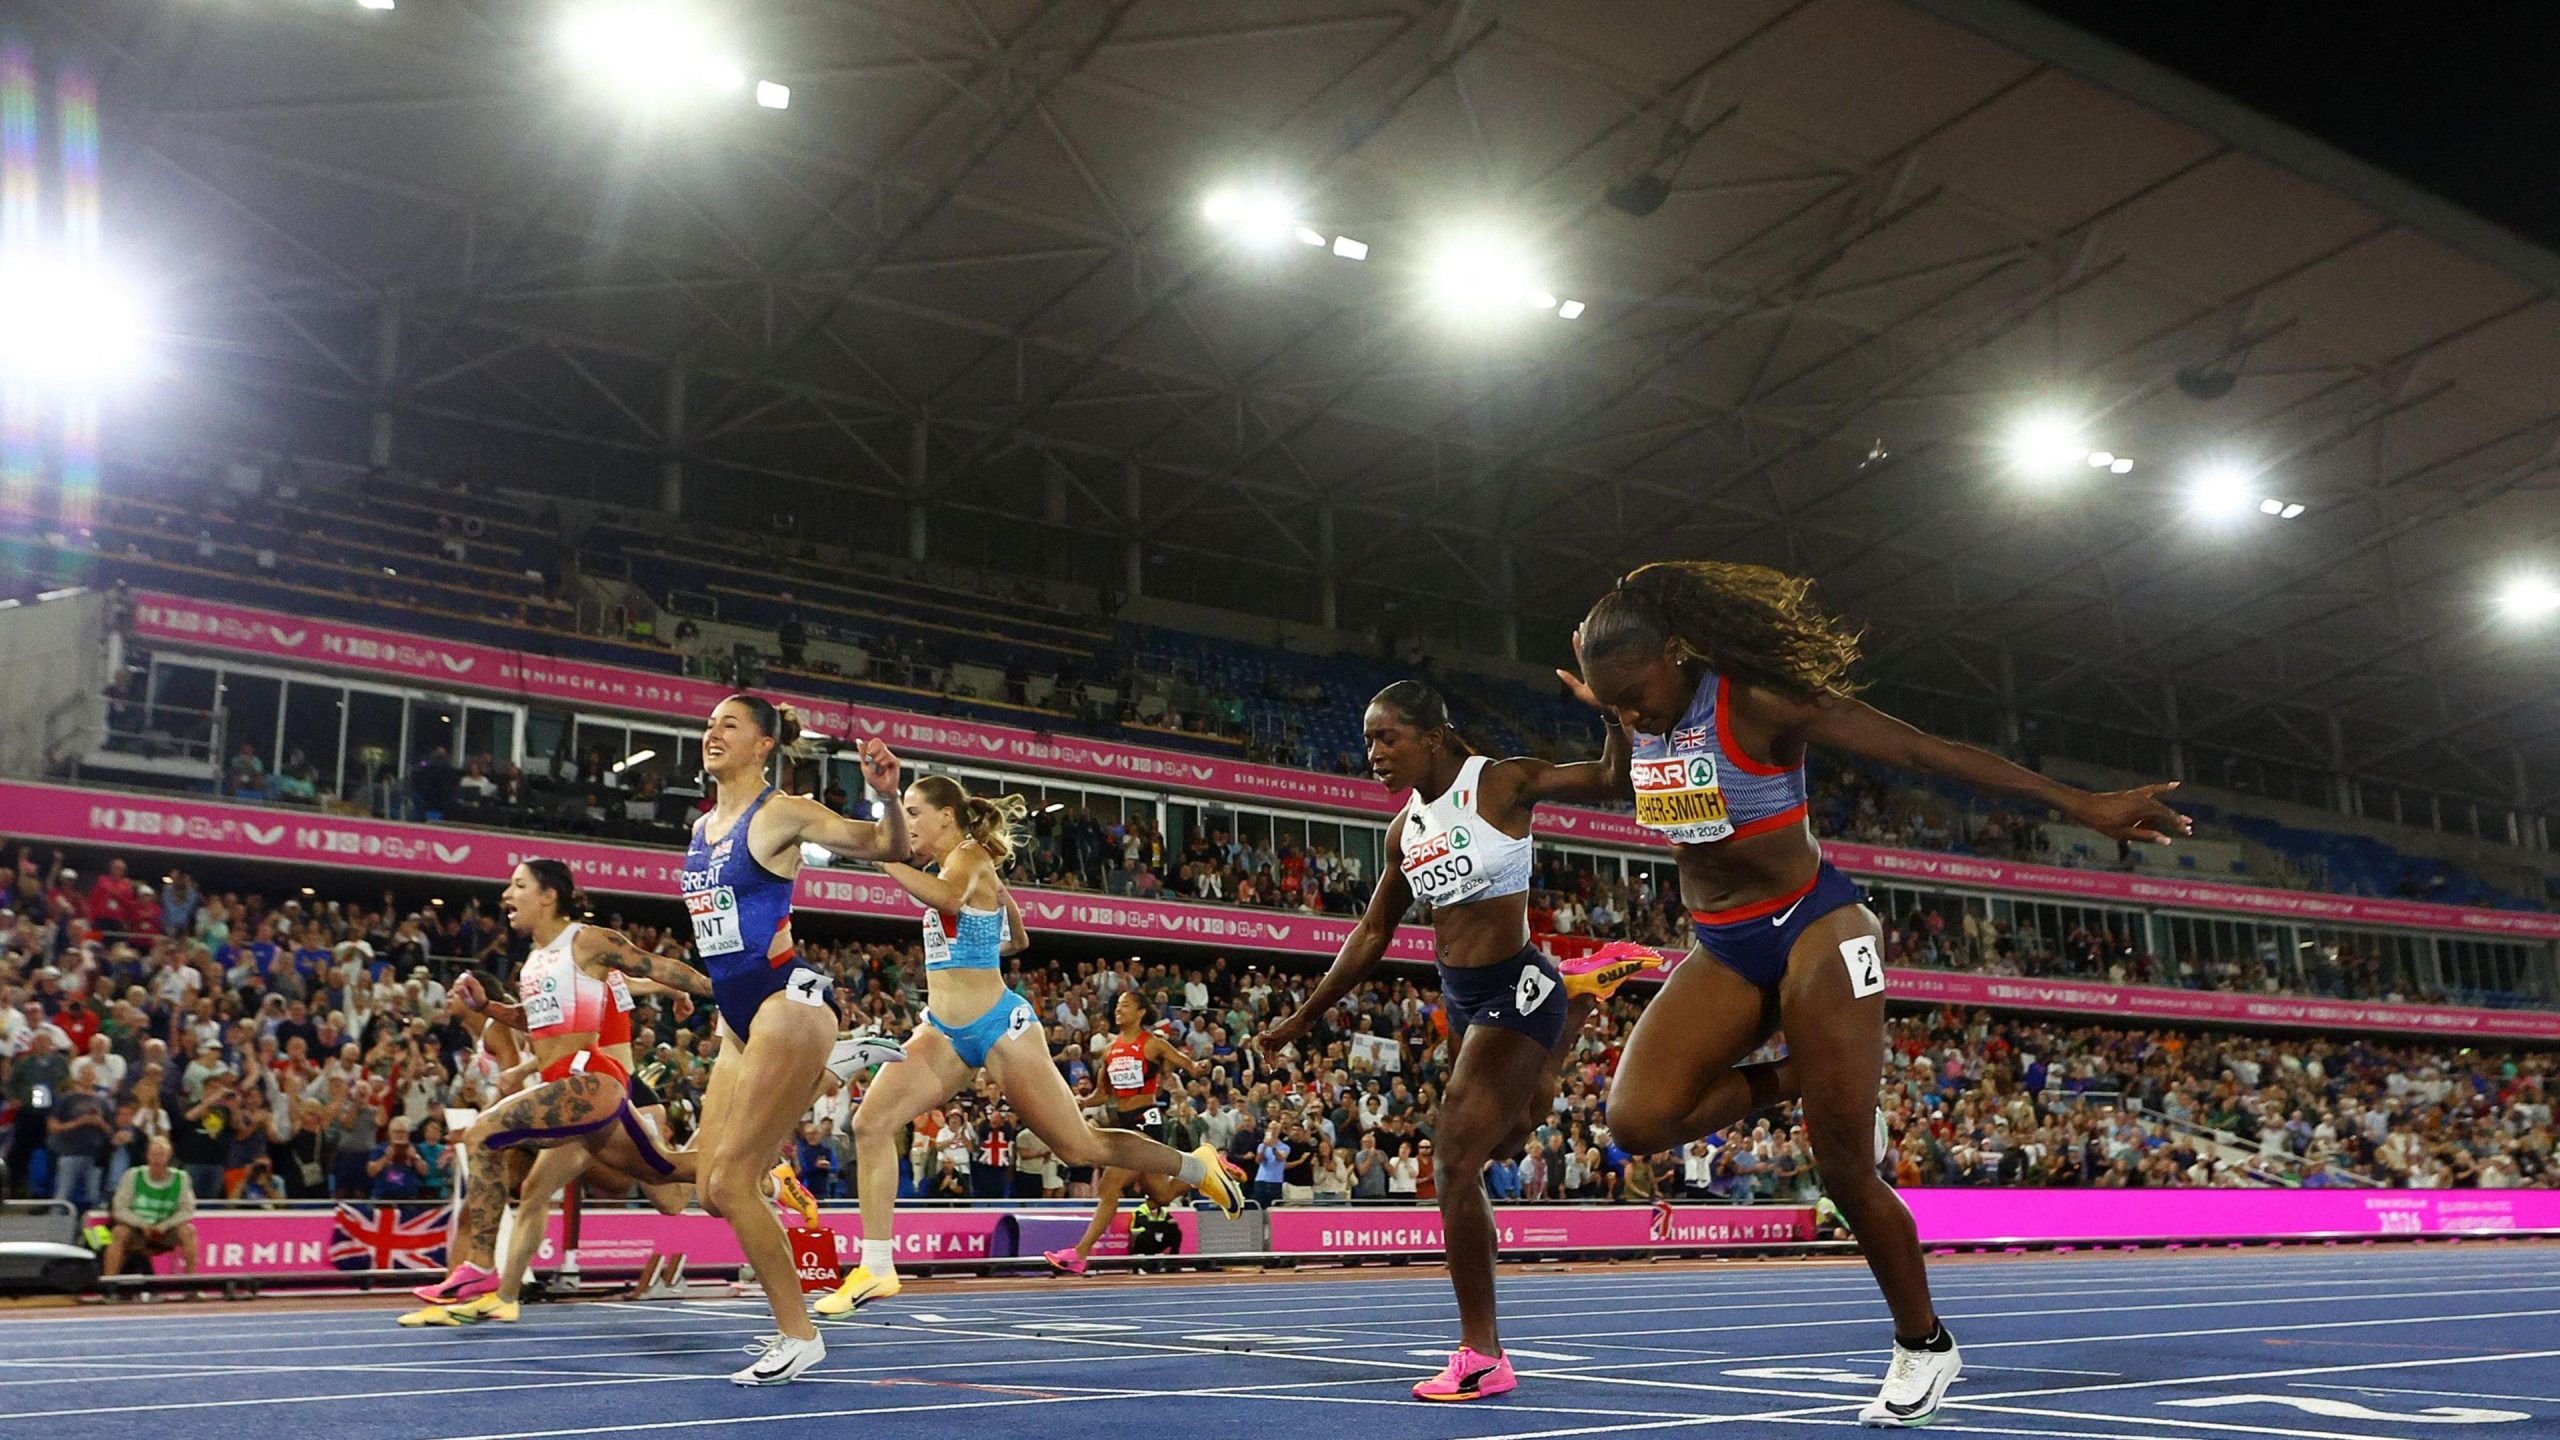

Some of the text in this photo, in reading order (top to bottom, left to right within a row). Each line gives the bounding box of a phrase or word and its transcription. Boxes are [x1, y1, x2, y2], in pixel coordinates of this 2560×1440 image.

[500, 664, 627, 694] BIRMINGHAM
[635, 685, 683, 702] 2026
[1234, 773, 1317, 793] BIRMINGHAM
[1698, 824, 1727, 838] 2026
[680, 863, 724, 891] GREAT
[1412, 854, 1473, 896] DOSSO
[1460, 878, 1484, 893] 2026
[695, 917, 724, 939] UNT
[1857, 945, 1878, 987] 2
[798, 979, 818, 999] 4
[1112, 1072, 1137, 1081] KORA
[1149, 1111, 1157, 1123] 9
[1322, 1229, 1445, 1247] BIRMINGHA
[796, 1268, 837, 1280] MEGA
